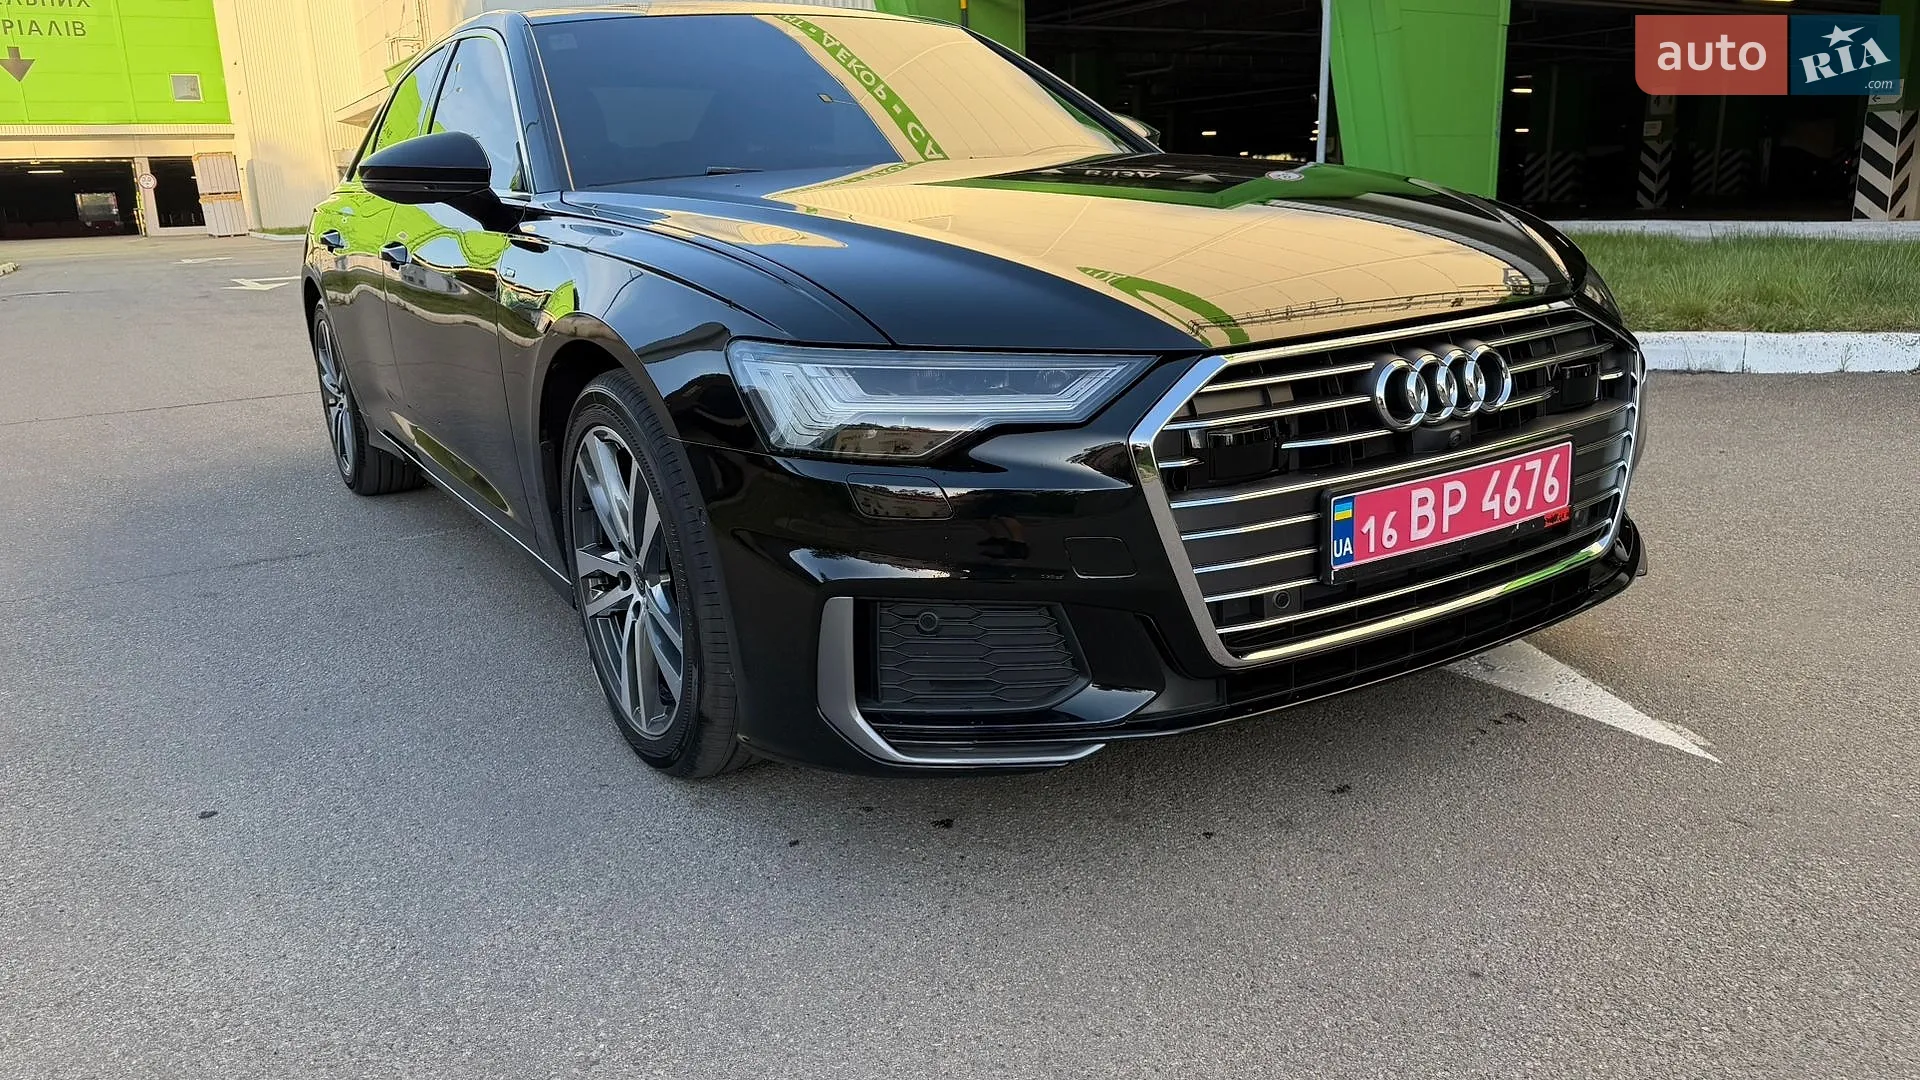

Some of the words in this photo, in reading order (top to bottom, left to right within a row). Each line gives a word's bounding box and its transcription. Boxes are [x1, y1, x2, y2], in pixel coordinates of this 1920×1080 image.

[2, 19, 87, 37] РІАЛІВ
[1361, 510, 1399, 553] 16
[1409, 480, 1468, 542] BP
[1481, 453, 1561, 520] 4676
[1333, 536, 1354, 558] UA
